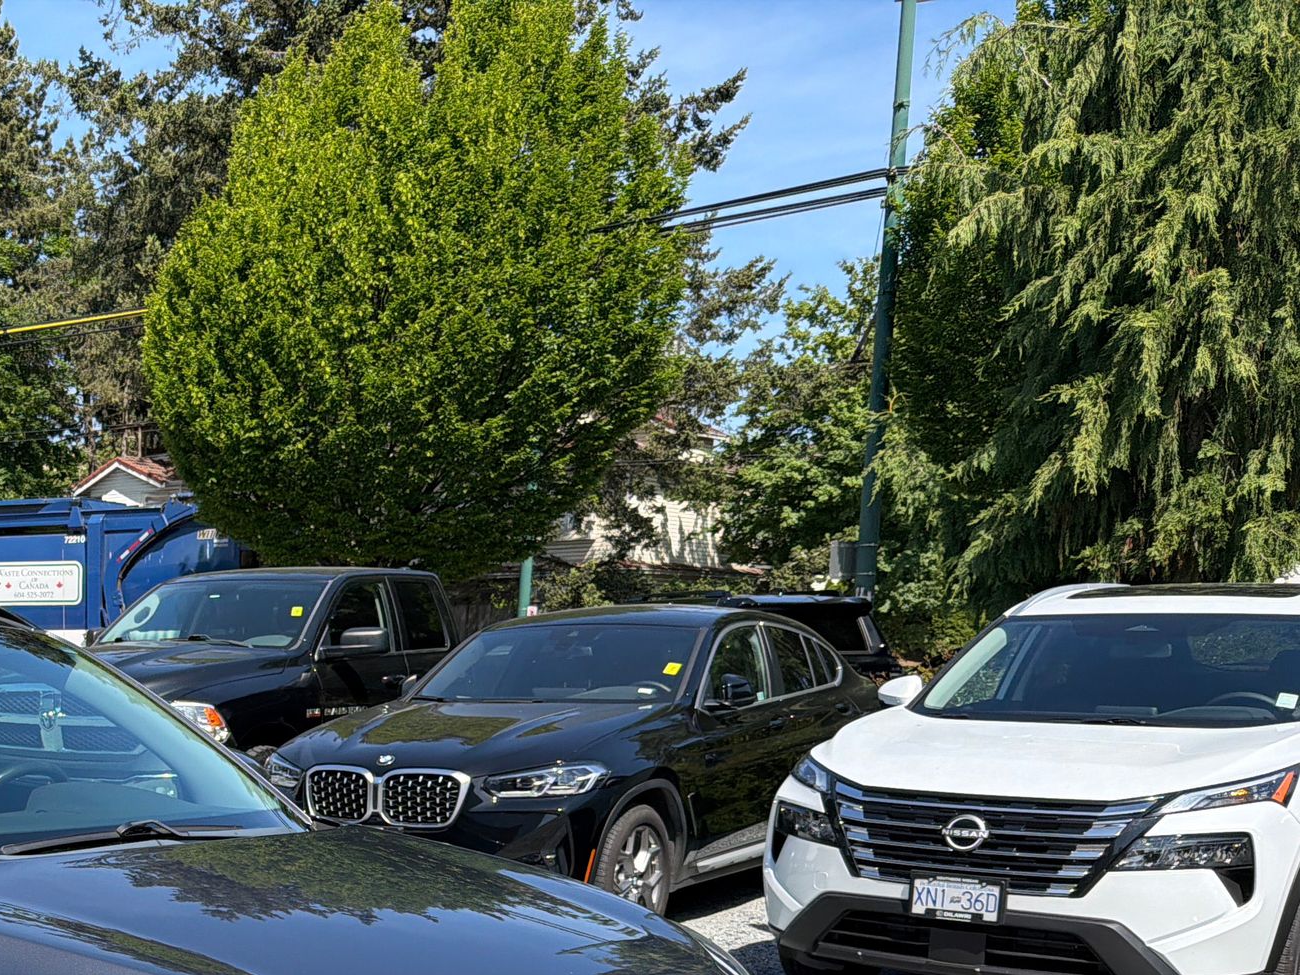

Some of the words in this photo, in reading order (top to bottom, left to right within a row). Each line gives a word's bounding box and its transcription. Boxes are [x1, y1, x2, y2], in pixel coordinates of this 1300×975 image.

[64, 535, 85, 544] 72210
[20, 568, 73, 577] CONNECTIONS
[19, 581, 49, 589] CANADA
[941, 828, 989, 839] NISSAN
